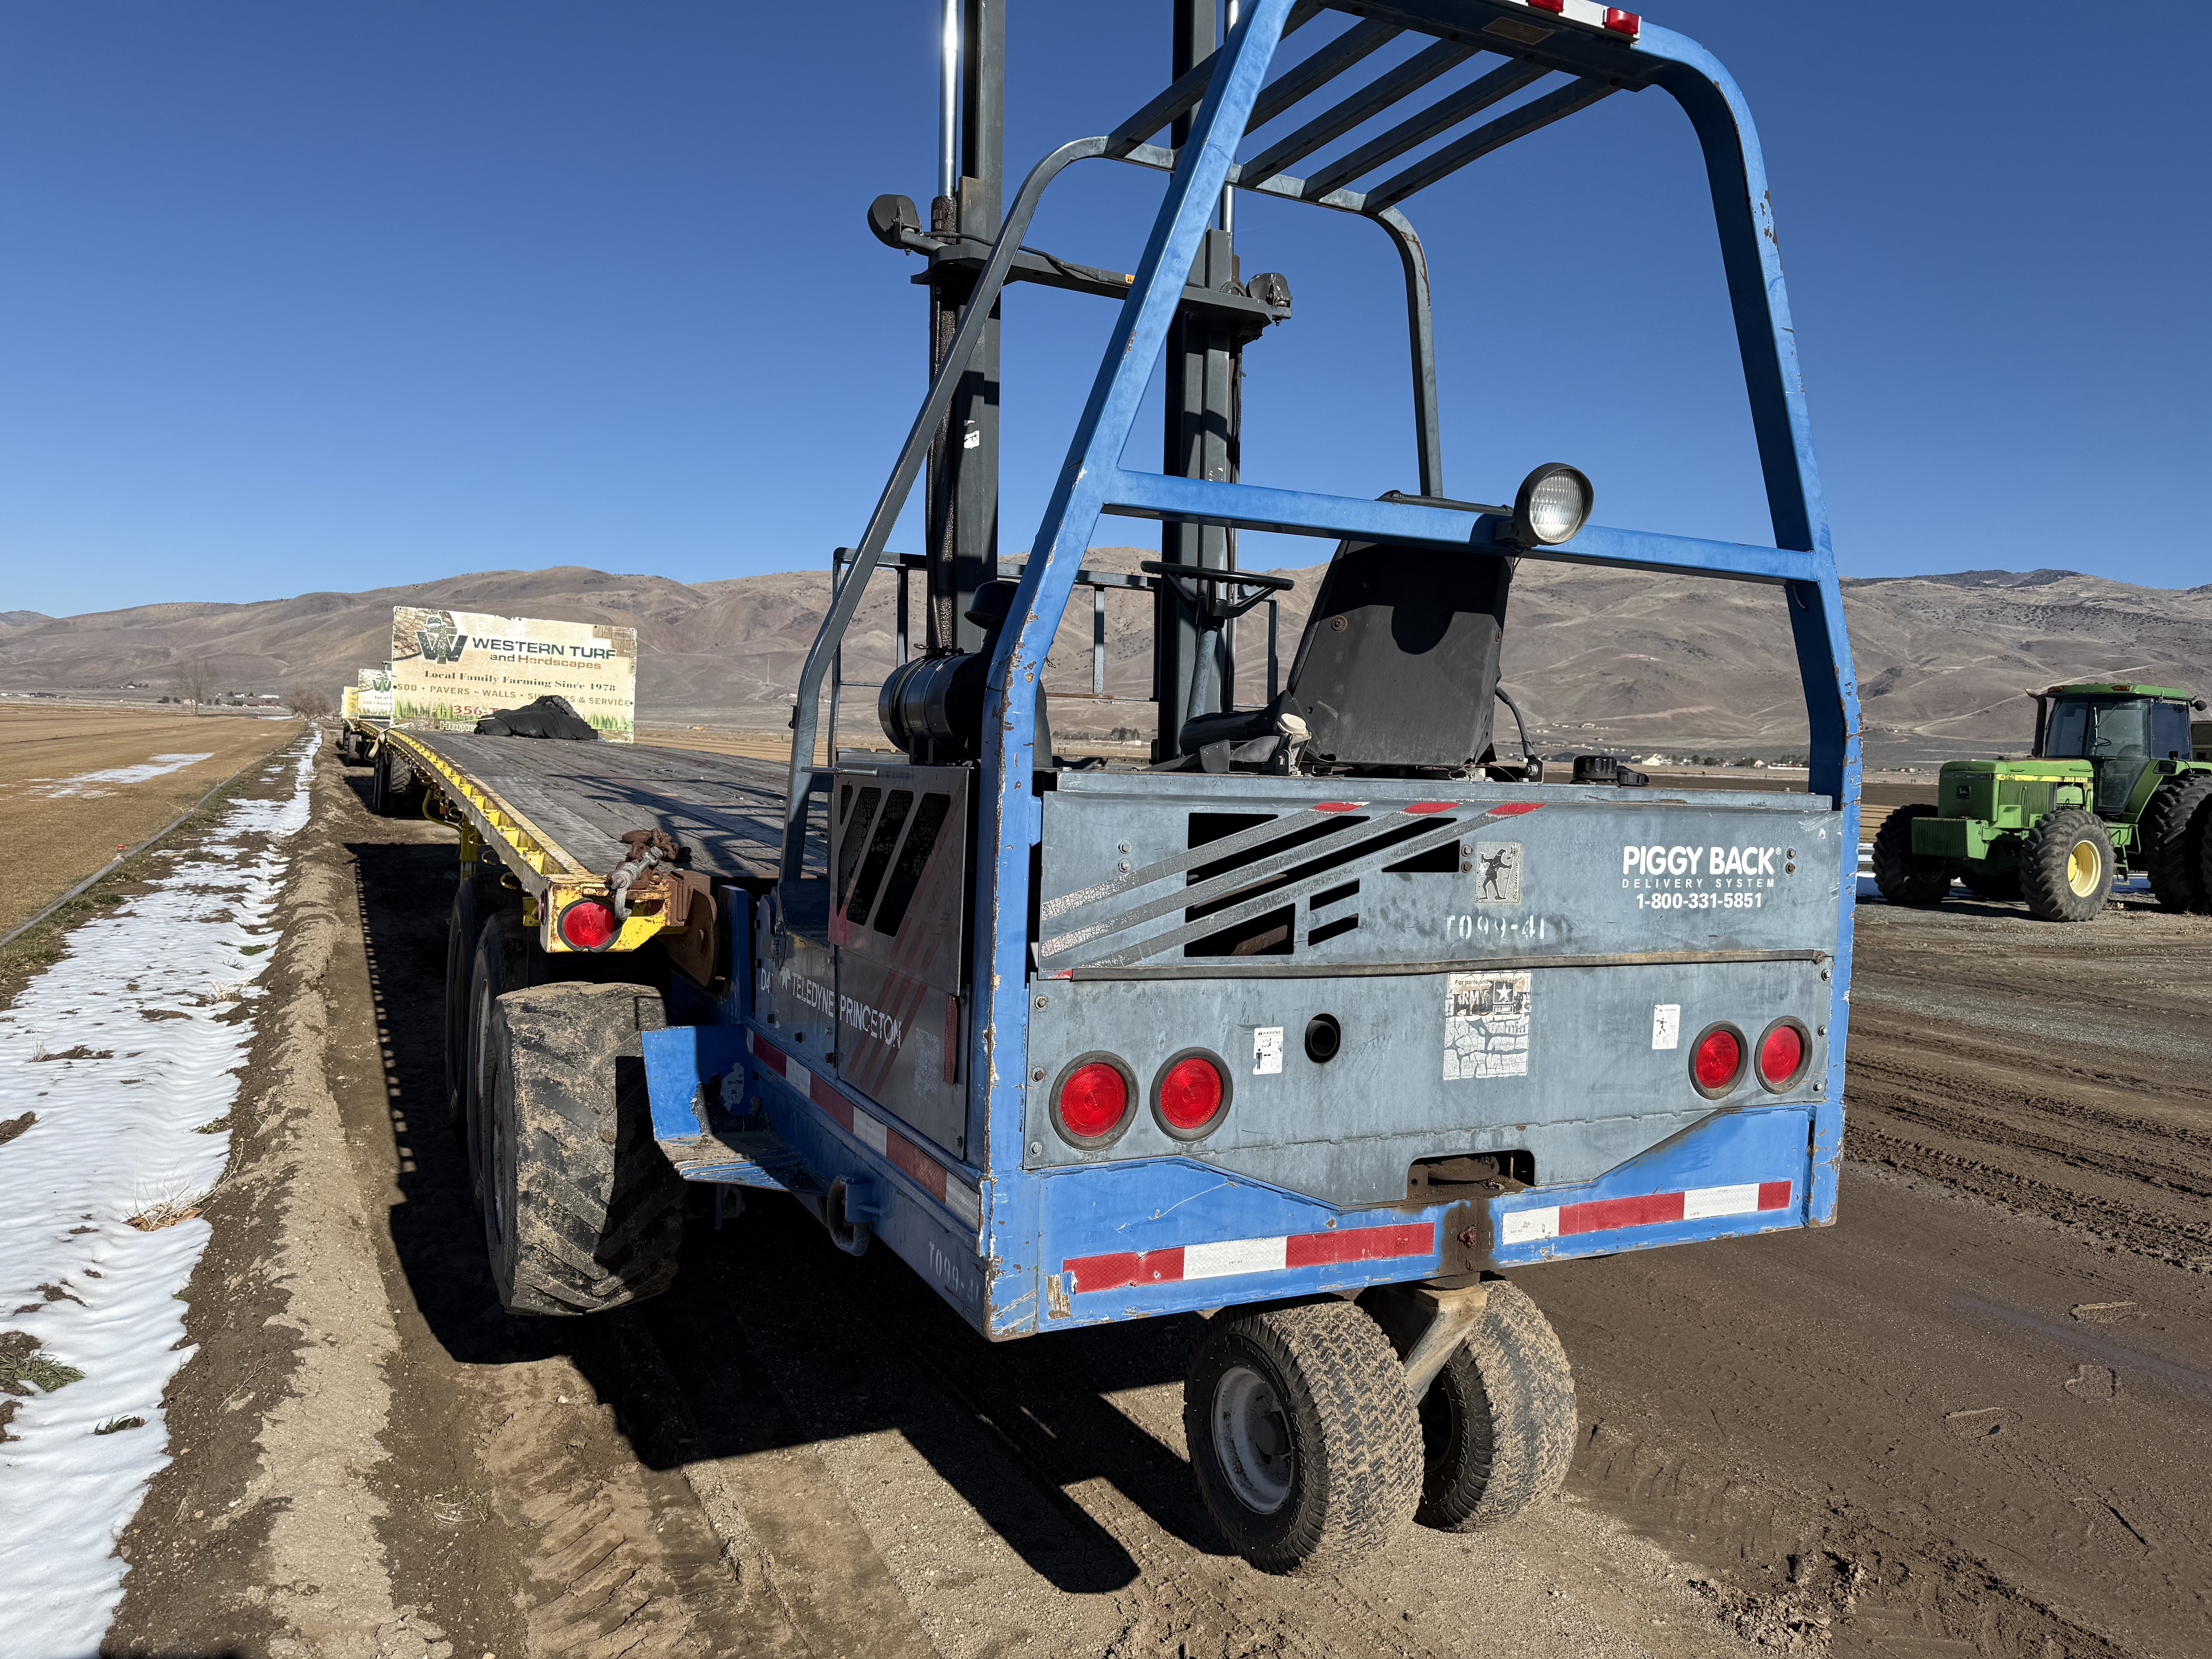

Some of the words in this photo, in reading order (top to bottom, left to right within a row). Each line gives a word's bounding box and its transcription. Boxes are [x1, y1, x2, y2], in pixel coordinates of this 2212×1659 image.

[472, 637, 564, 656] WESTERN
[569, 646, 616, 659] TURF
[518, 655, 601, 669] Hardscapes
[425, 670, 455, 679] Local
[460, 673, 499, 684] Family
[503, 677, 551, 688] Farming
[555, 680, 585, 689] Since
[591, 683, 616, 691] 1978
[430, 686, 470, 695] PAVERS
[482, 690, 516, 698] WALLS
[589, 697, 630, 707] SERVICE
[453, 705, 499, 715] 356-T
[440, 721, 476, 732] Home
[1623, 846, 1704, 875] PIGGY
[1622, 878, 1703, 888] DELIVERY
[1716, 878, 1774, 888] SYSTEM
[1637, 892, 1762, 909] 1-800-331-5851
[792, 972, 835, 1018] TELEDYNE
[840, 994, 902, 1049] PRINCETON
[1290, 1412, 1307, 1494] MULTI
